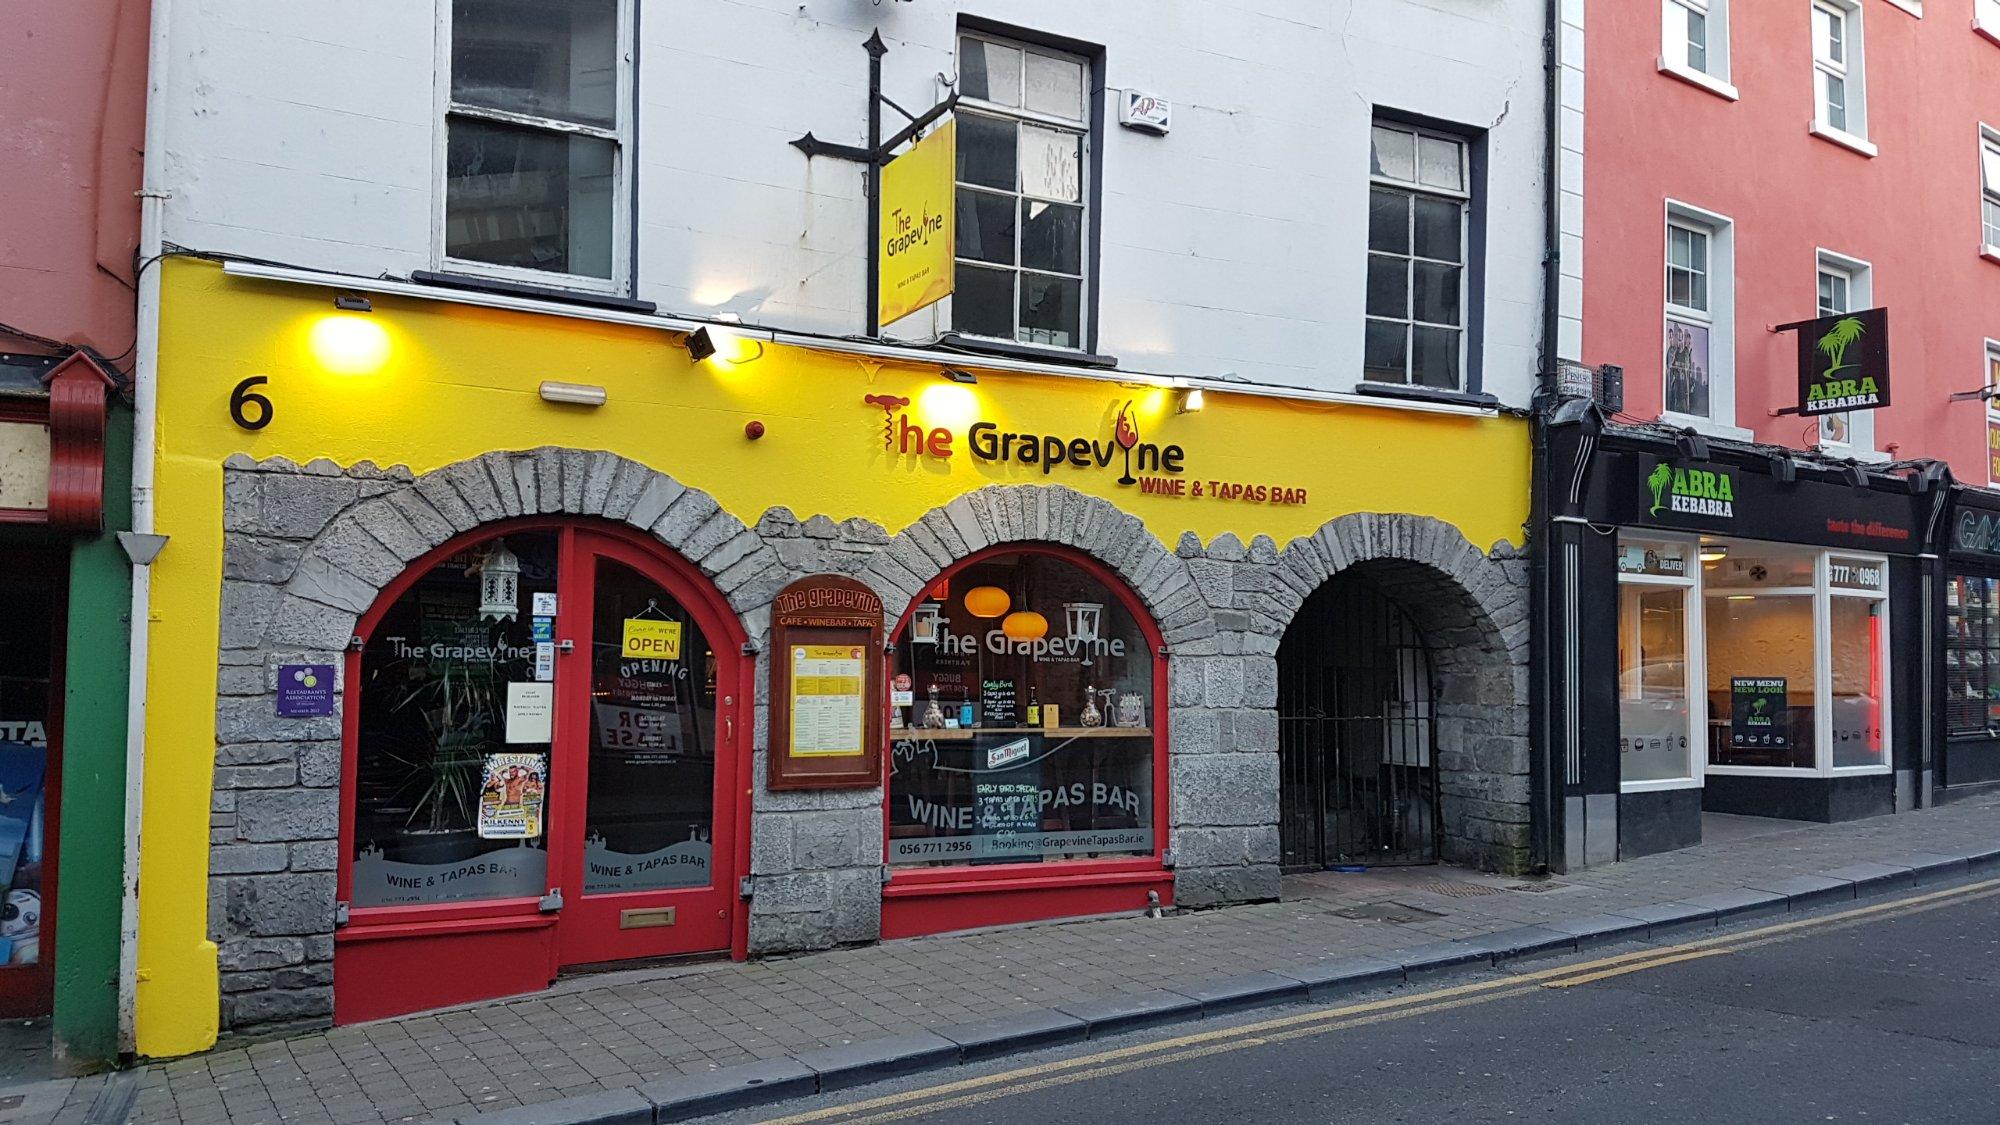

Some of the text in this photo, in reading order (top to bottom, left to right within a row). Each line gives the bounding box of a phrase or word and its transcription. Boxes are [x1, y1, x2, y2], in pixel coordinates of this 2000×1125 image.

[887, 200, 943, 257] Grapevine
[892, 208, 911, 234] The
[1807, 376, 1878, 401] ABRA
[229, 375, 273, 430] 6
[1807, 393, 1879, 412] KEBABRA
[864, 393, 952, 458] The
[968, 400, 1185, 485] Grapevine
[1139, 476, 1308, 505] WINE & TAPAS BAR
[1672, 467, 1734, 501] ABRA
[1671, 494, 1734, 518] KEBABRA
[1850, 519, 1866, 535] the
[1866, 521, 1910, 539] difference
[1860, 567, 1880, 586] 0968
[777, 588, 881, 614] The grapevine
[780, 617, 878, 628] CAFE WINEBAR TAPAS
[628, 638, 675, 653] OPEN
[922, 615, 976, 655] The
[387, 637, 424, 658] The
[430, 632, 530, 664] Grapevine
[620, 660, 689, 680] OPENING
[1000, 680, 1013, 688] Bird
[989, 743, 1027, 764] San Miguel
[976, 784, 1039, 794] EARLY BIRD SPECIAL
[907, 782, 1140, 829] WINE & TAPAS BAR
[899, 840, 972, 854] 056 771 2956
[386, 872, 422, 888] WINE
[426, 876, 435, 887] &
[440, 864, 486, 883] TAPAS
[590, 854, 705, 876] WINE & TAPAS BAR
